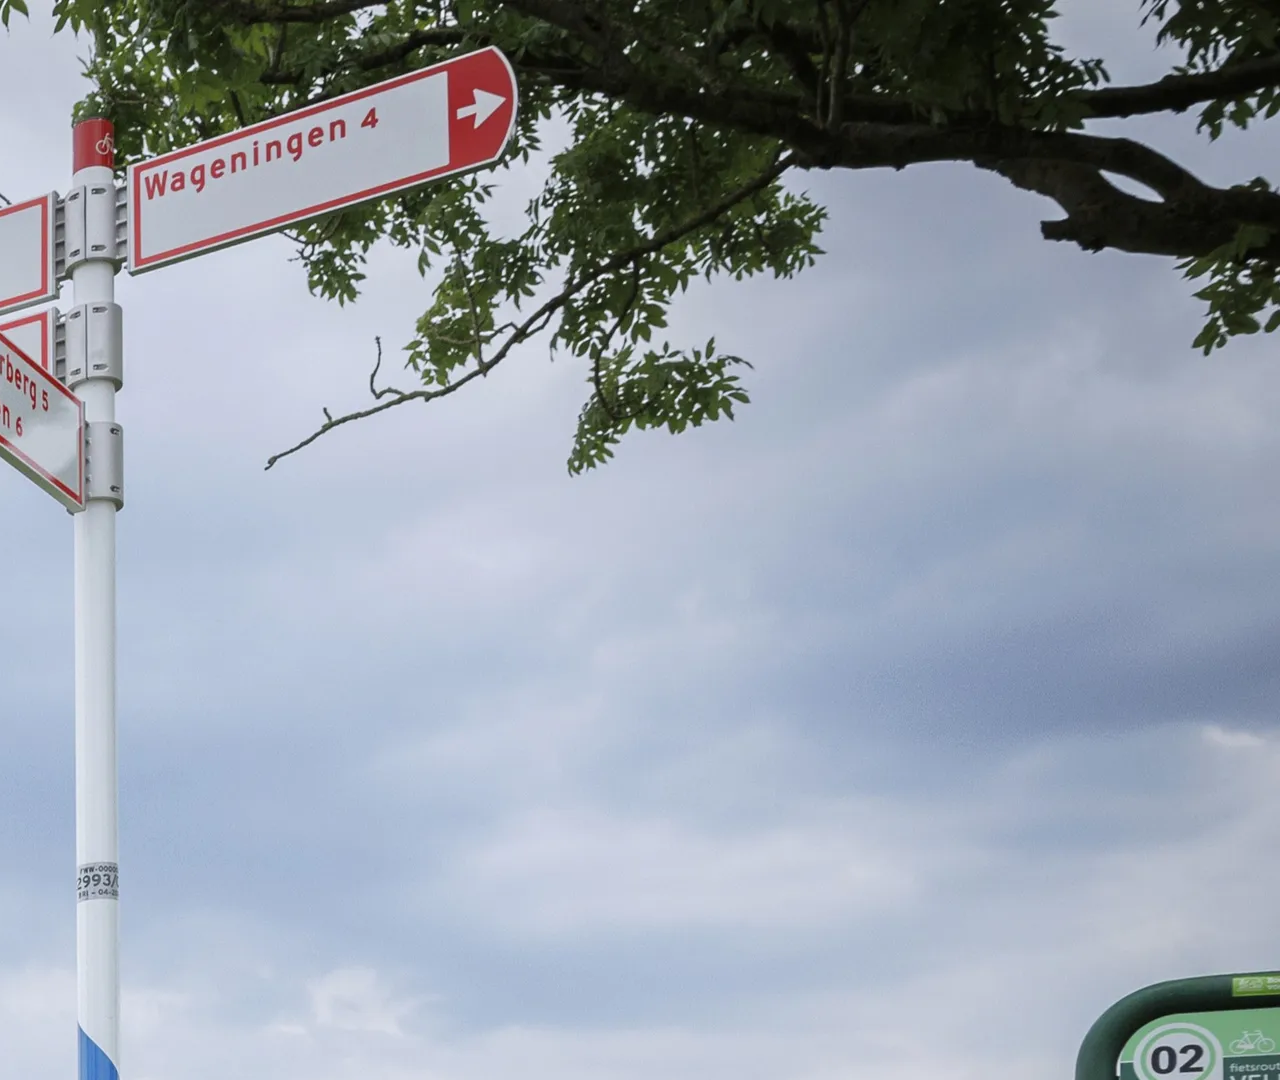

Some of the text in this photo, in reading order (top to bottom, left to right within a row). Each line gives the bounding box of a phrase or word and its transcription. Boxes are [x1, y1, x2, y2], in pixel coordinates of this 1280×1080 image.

[144, 107, 379, 200] Wageningen 4
[42, 389, 49, 412] 5
[15, 416, 23, 437] 6
[1150, 1044, 1204, 1075] 02
